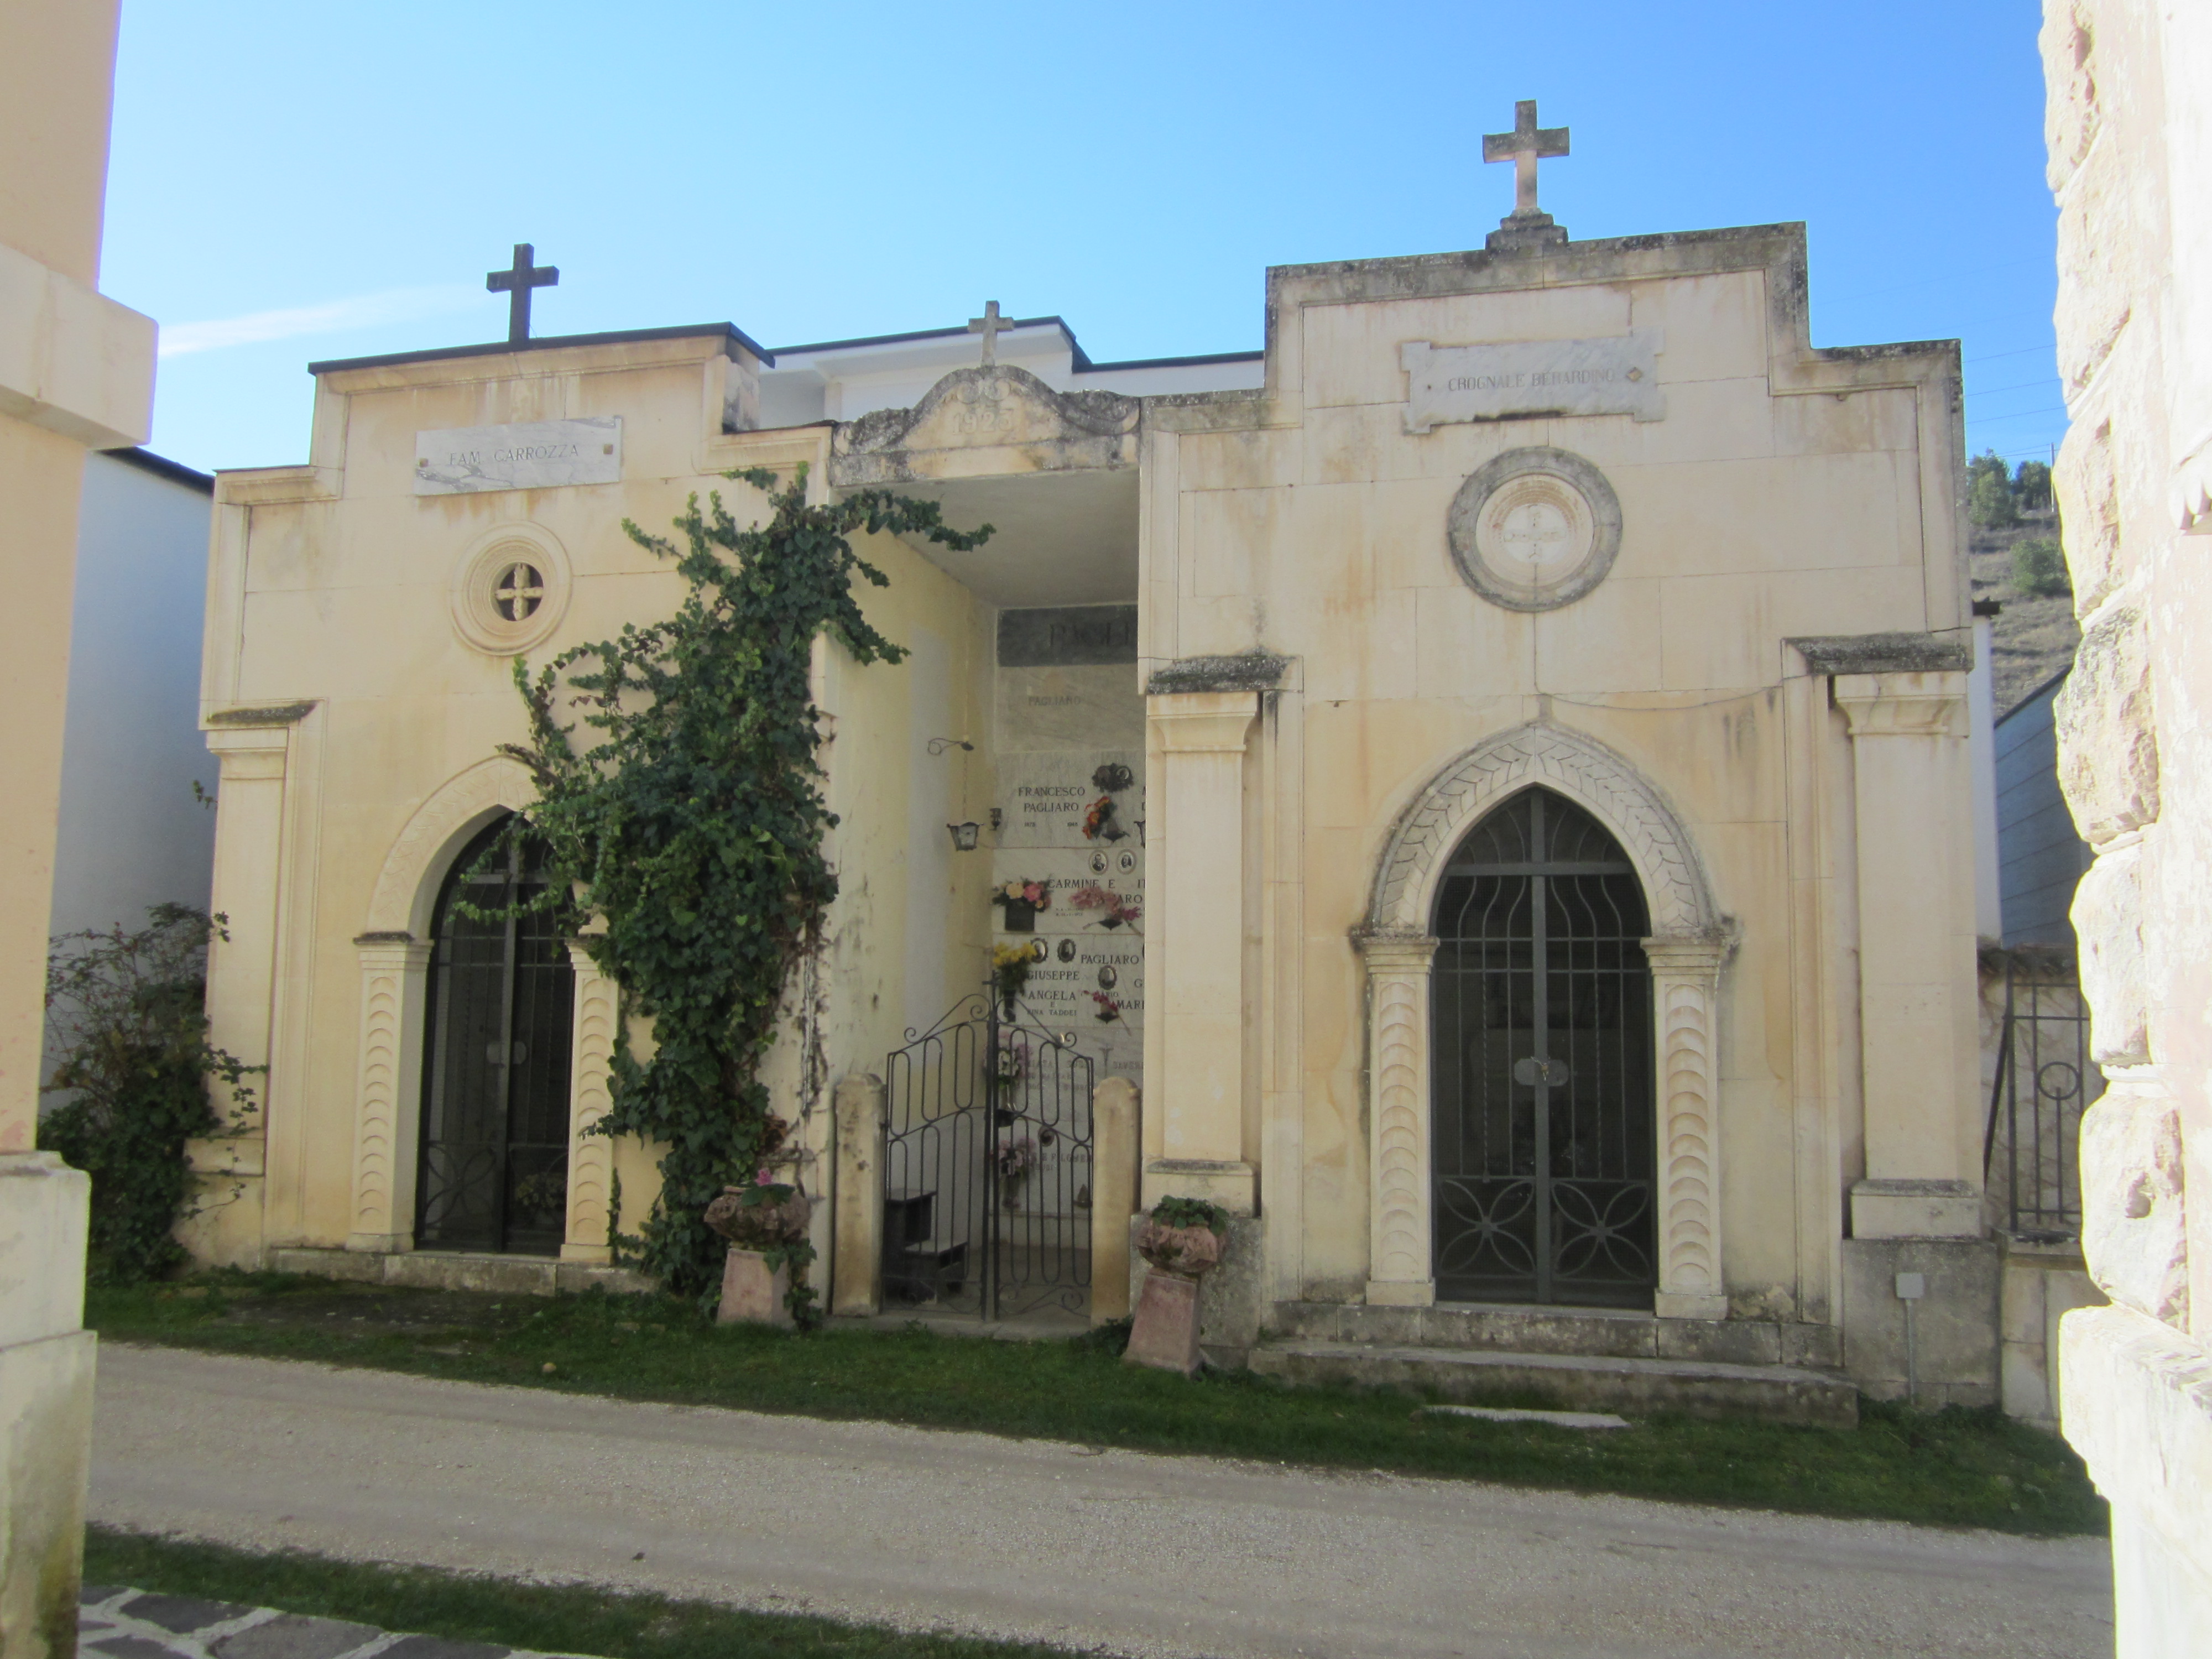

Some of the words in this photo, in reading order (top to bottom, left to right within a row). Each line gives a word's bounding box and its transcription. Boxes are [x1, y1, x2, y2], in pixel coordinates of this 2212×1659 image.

[1448, 374, 1525, 391] CROGNALE
[1532, 368, 1615, 387] BERARDINO
[494, 445, 579, 462] CARROZZA
[1018, 786, 1086, 797] FRANCESCO
[1024, 802, 1079, 812] PAGLIARO
[1048, 879, 1098, 889] CARMINE
[1109, 879, 1115, 889] E
[1081, 954, 1139, 964] PAGLIARO
[1027, 970, 1079, 980] GIUSEPPE
[1028, 990, 1076, 1000] ANGELA
[1117, 999, 1144, 1010] MARI
